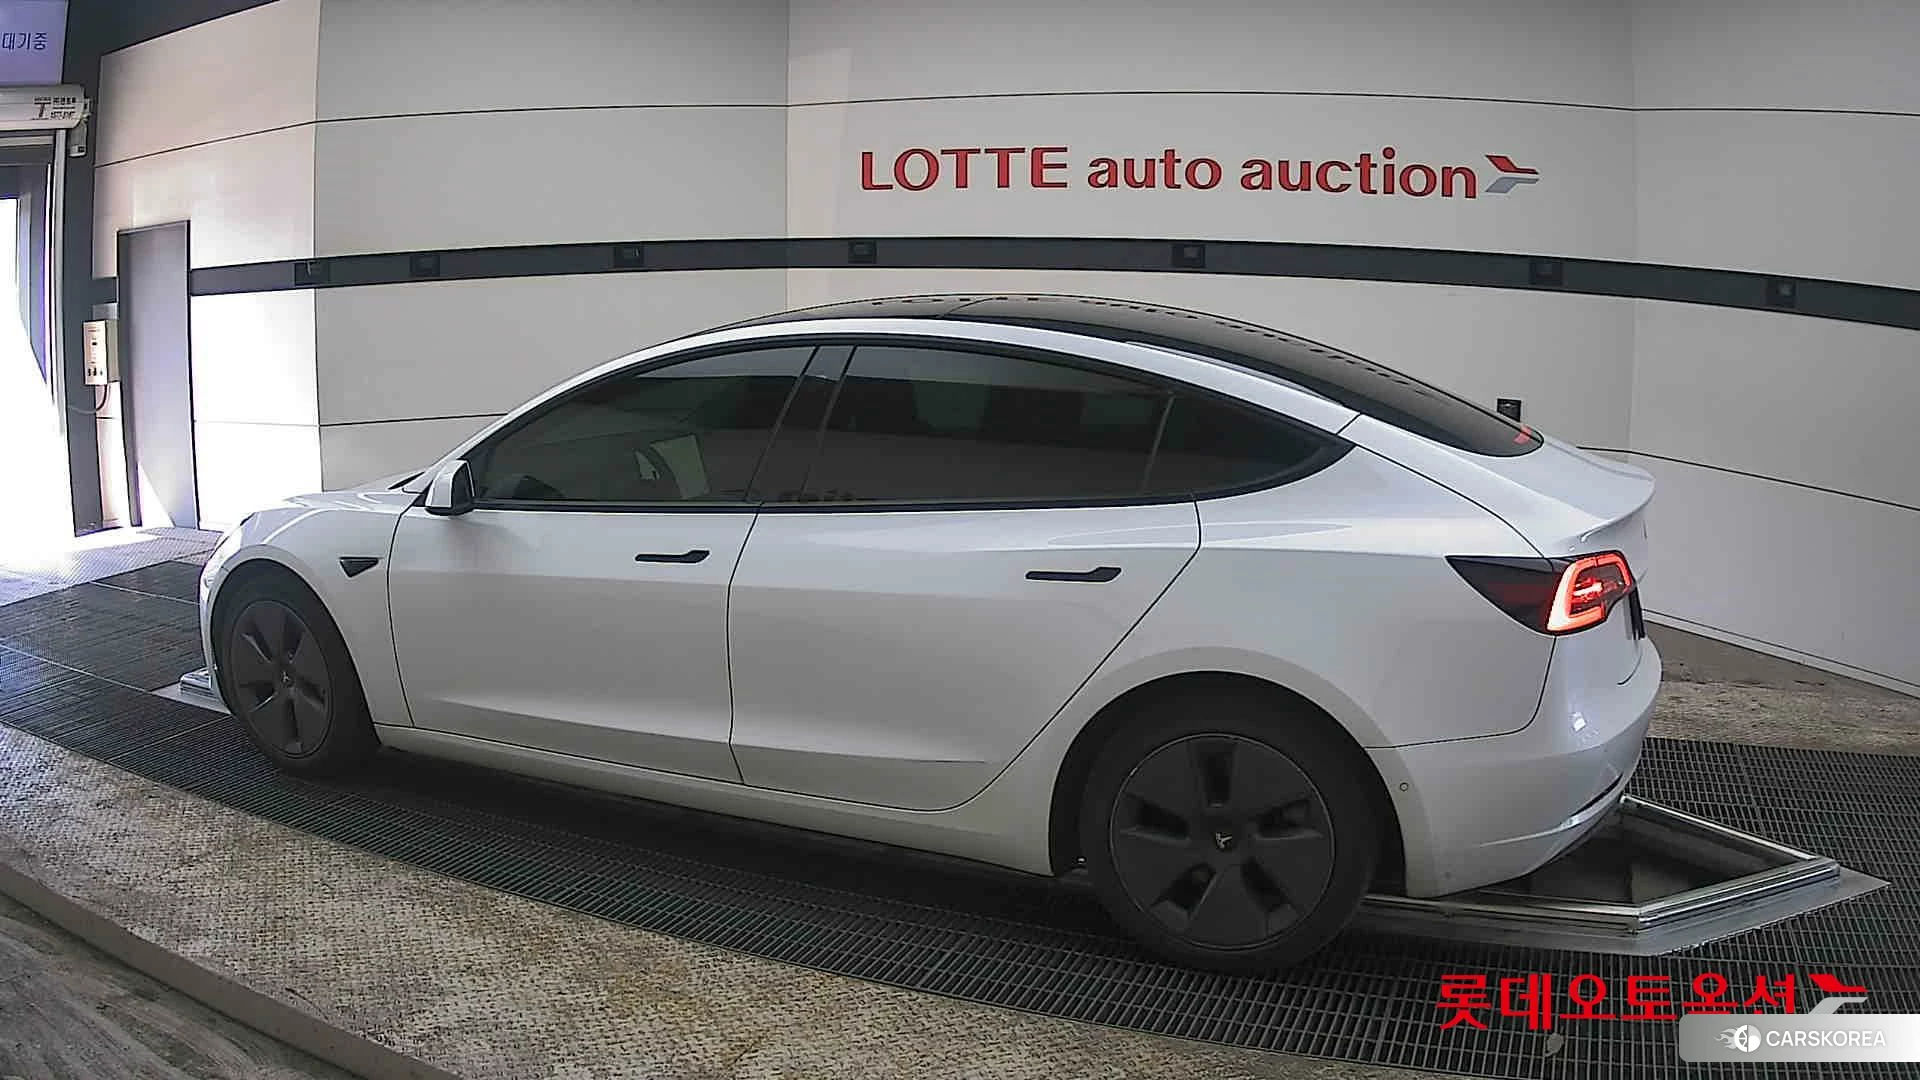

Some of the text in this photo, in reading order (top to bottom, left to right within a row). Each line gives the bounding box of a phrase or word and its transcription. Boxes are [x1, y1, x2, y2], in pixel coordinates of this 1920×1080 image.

[2, 32, 49, 51] 대기중
[861, 147, 1478, 199] LOTTE auto auction
